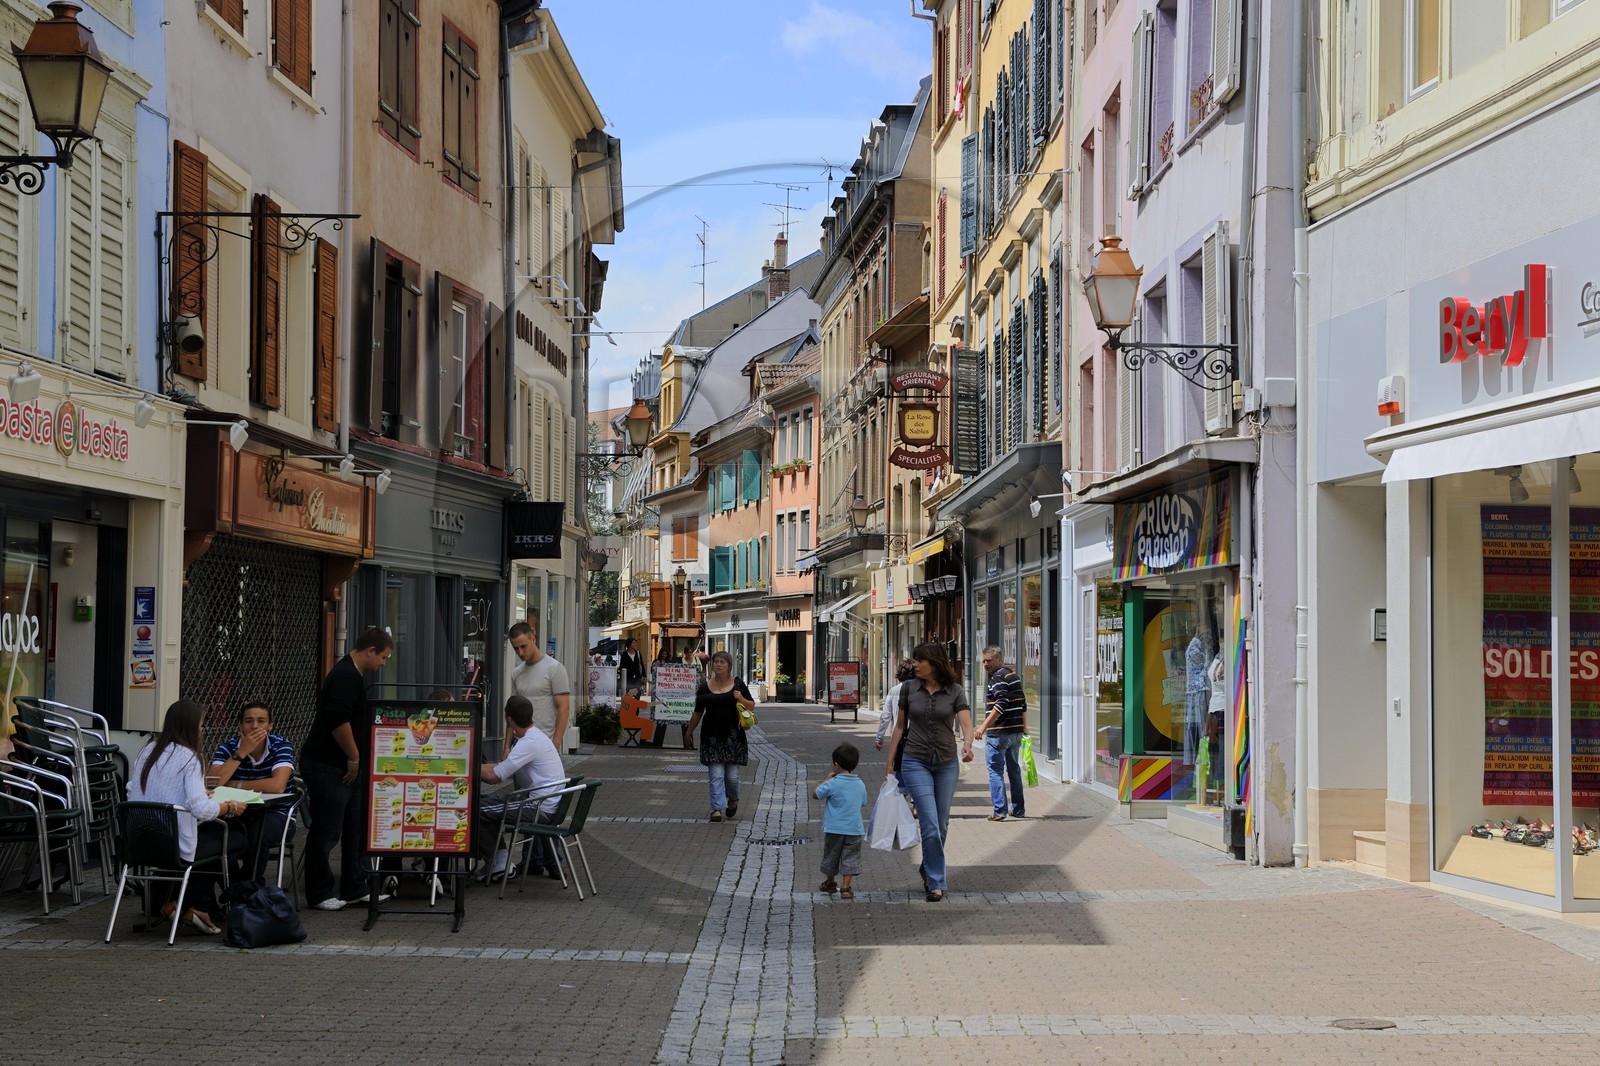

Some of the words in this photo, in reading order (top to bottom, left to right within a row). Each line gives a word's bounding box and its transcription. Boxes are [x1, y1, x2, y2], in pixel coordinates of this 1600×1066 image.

[1440, 263, 1546, 367] Beryl
[896, 371, 942, 383] RESTAURANT
[902, 378, 937, 387] ORIENTAL
[81, 408, 128, 460] basta
[898, 453, 942, 465] SPECIALITES
[1135, 493, 1193, 536] TRICOT
[431, 508, 465, 534] IKKS
[514, 535, 555, 544] IKKS
[590, 547, 621, 555] MATY
[1485, 648, 1600, 680] SOLDES
[375, 708, 406, 718] Pasta
[1497, 754, 1530, 762] PALLADIUM
